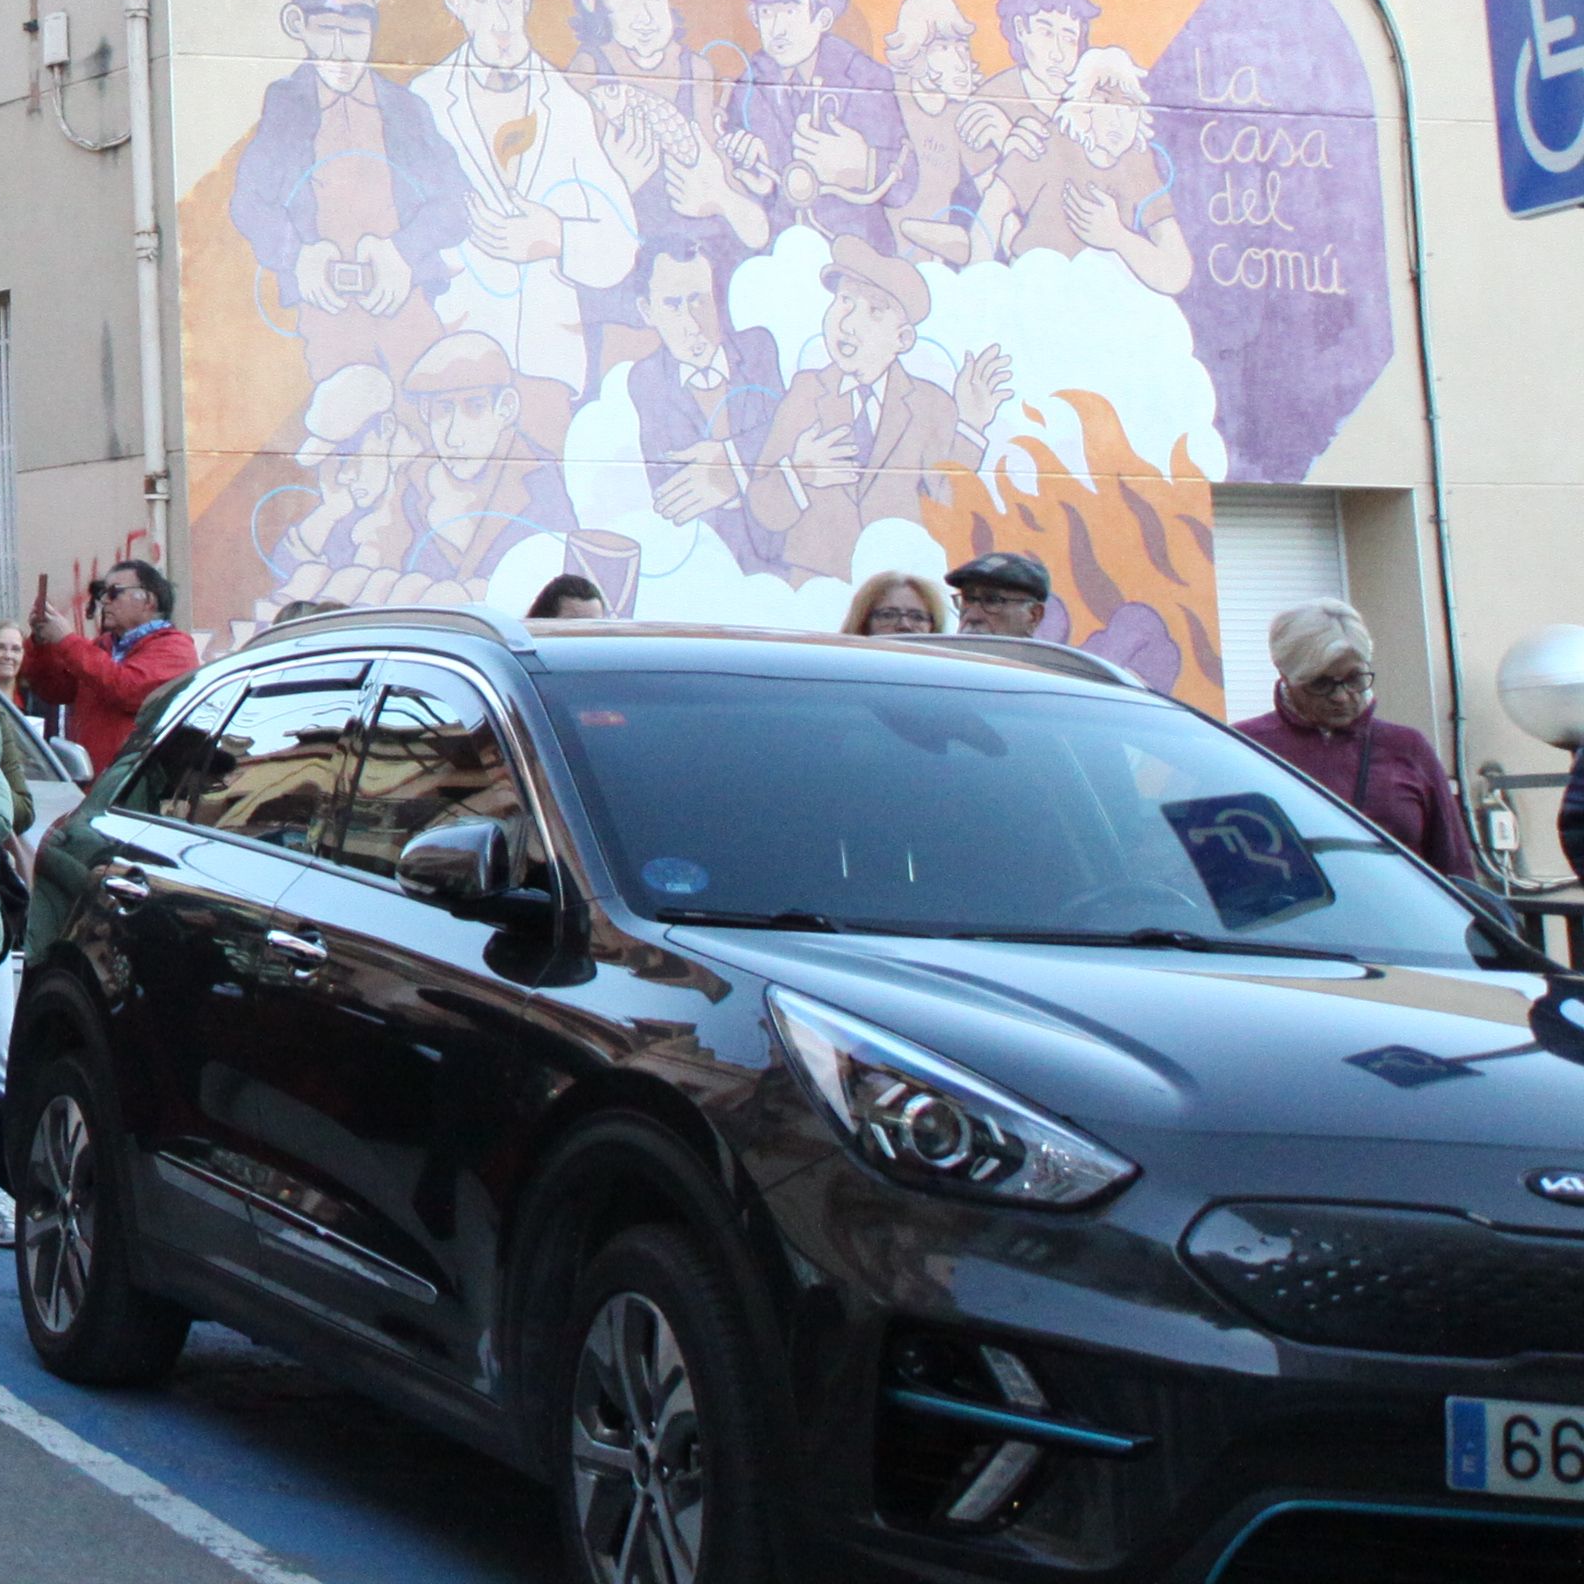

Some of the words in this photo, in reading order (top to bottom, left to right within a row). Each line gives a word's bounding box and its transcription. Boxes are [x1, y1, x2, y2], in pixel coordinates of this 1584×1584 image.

[1195, 47, 1272, 107] La
[1209, 170, 1295, 232] del
[1503, 1414, 1584, 1484] 66
